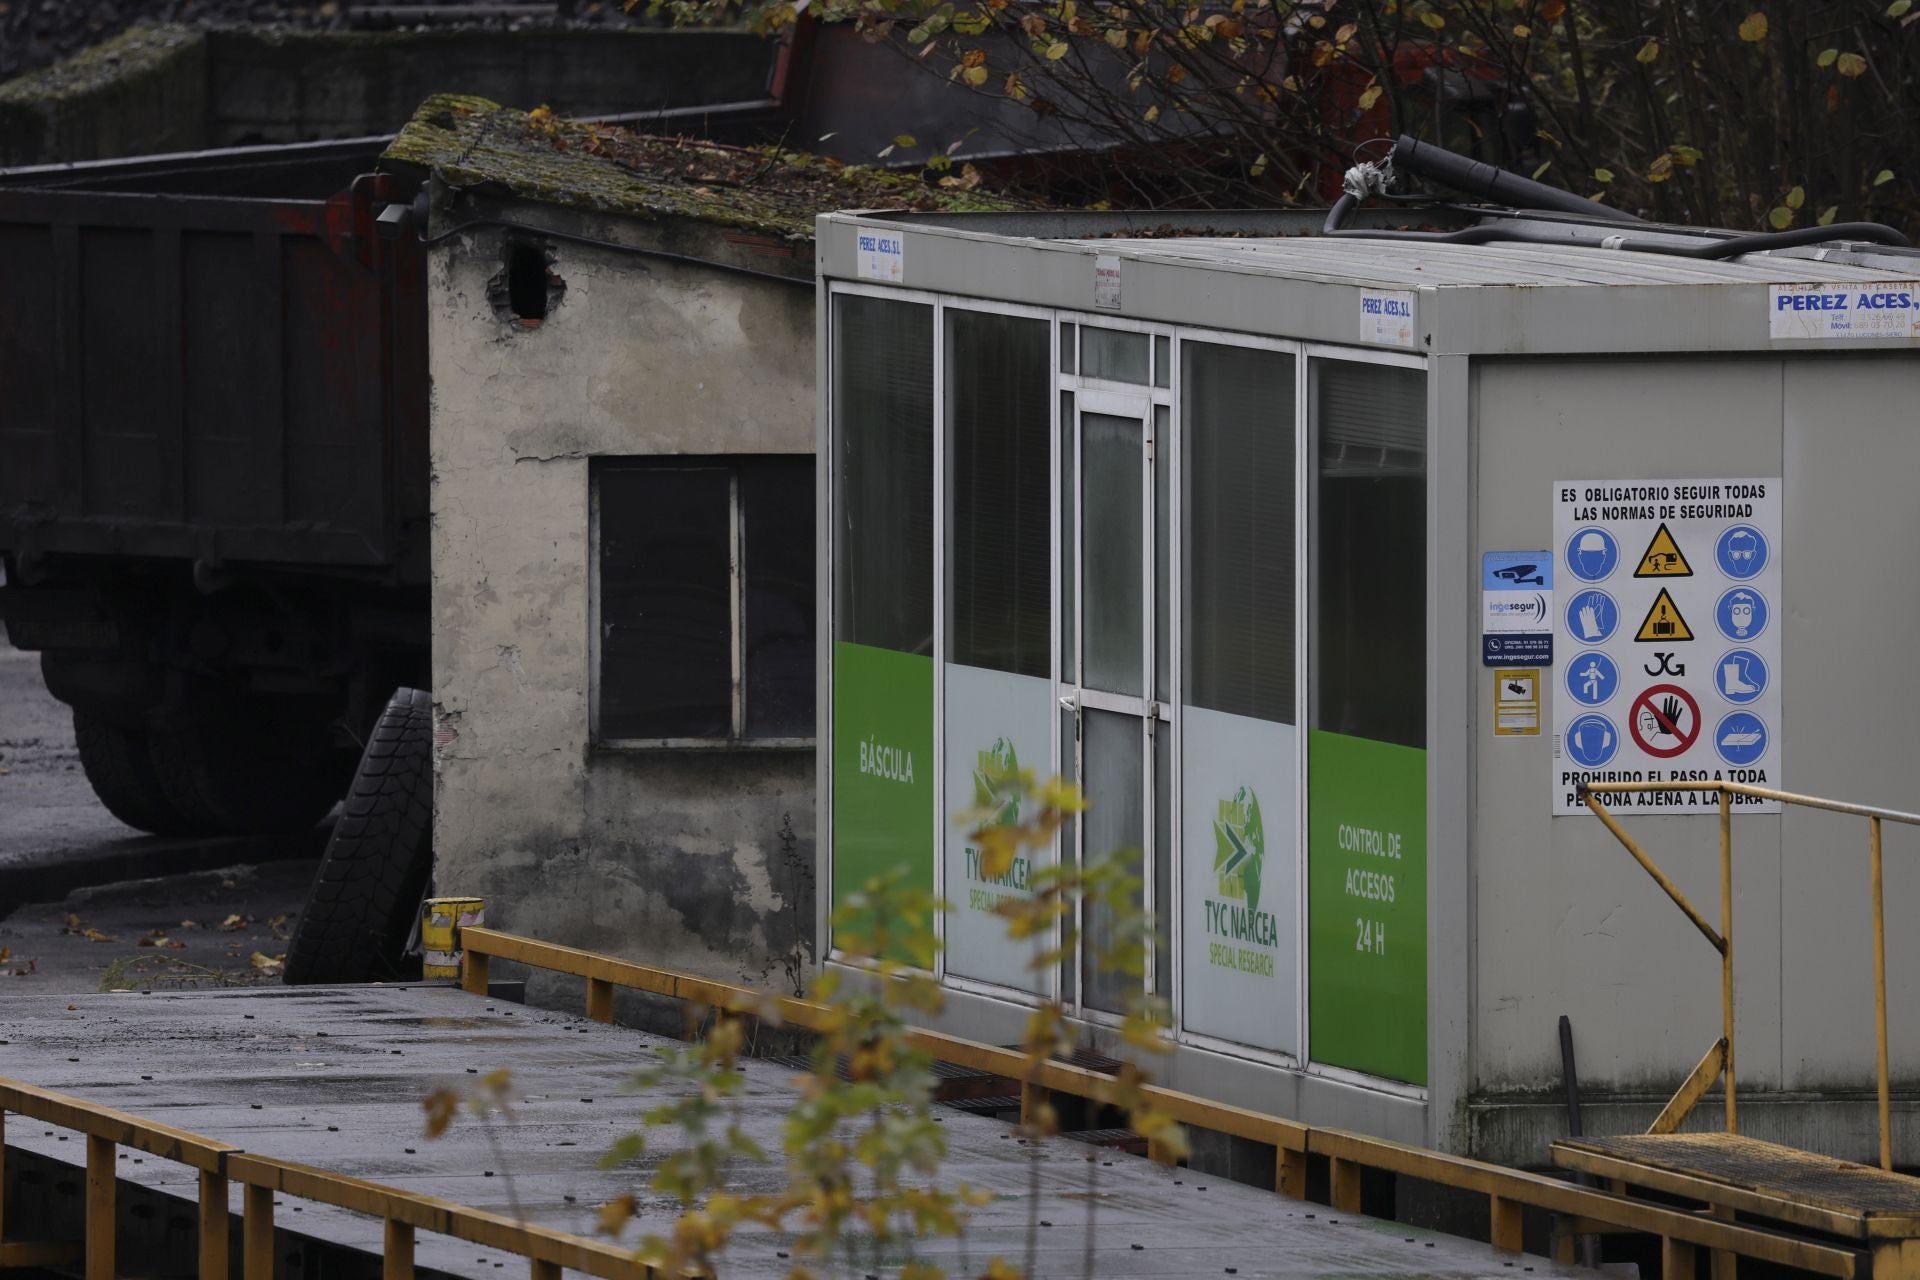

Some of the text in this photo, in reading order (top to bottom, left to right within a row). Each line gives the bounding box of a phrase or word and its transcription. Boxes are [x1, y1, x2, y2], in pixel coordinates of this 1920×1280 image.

[860, 236, 876, 251] PEREZ
[1362, 297, 1382, 314] PEREZ
[1778, 294, 1847, 311] PEREZ
[1561, 485, 1765, 502] ES OBLIGATORIO SEGUIR TODAS
[1574, 504, 1753, 521] LAS NORMAS DE SEGURIDAD
[1490, 602, 1535, 612] ingesegur
[860, 734, 914, 784] BÁSCULA
[1562, 769, 1767, 785] PROHIBIDO EL PASO A TODA
[1567, 792, 1632, 806] PESONA
[1637, 791, 1683, 806] AJENA
[1688, 791, 1697, 805] A
[1703, 791, 1720, 805] LA
[1338, 824, 1401, 859] CONTROL DE
[1346, 868, 1395, 902] ACCESOS
[970, 888, 994, 913] SPECIAL
[1205, 900, 1278, 948] TYC NARCEA
[1356, 918, 1385, 955] 24 H
[1209, 943, 1274, 978] SPECIAL RESEARCH
